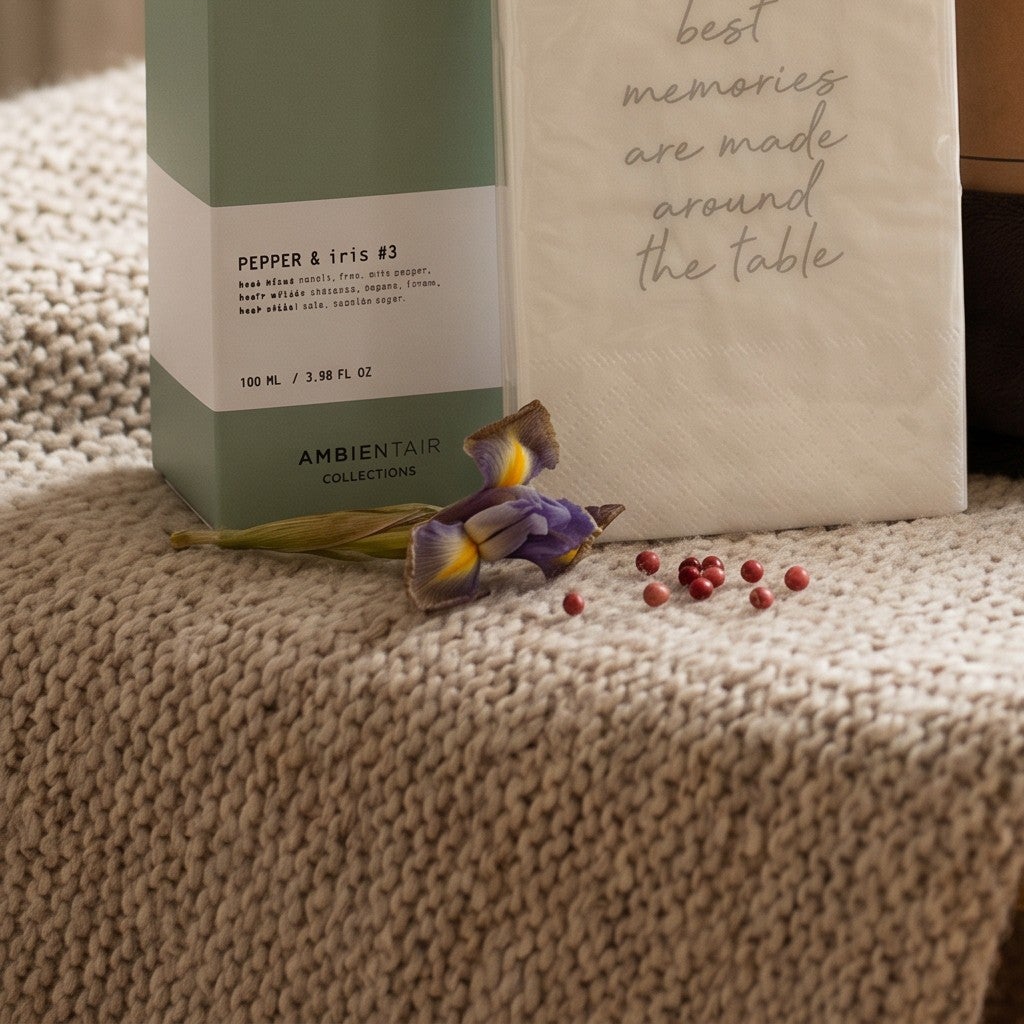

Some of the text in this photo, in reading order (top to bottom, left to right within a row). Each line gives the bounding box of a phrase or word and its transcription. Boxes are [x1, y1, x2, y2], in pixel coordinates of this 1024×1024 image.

[622, 66, 848, 107] memories
[624, 100, 848, 165] are made
[652, 159, 825, 220] around
[238, 245, 398, 271] PEPPER & iris #3
[636, 221, 844, 291] the table
[240, 367, 372, 388] 100 ML / 3.98 FL OZ
[299, 438, 441, 465] AMBIENTAIR
[322, 466, 416, 484] COLLECTIONS
